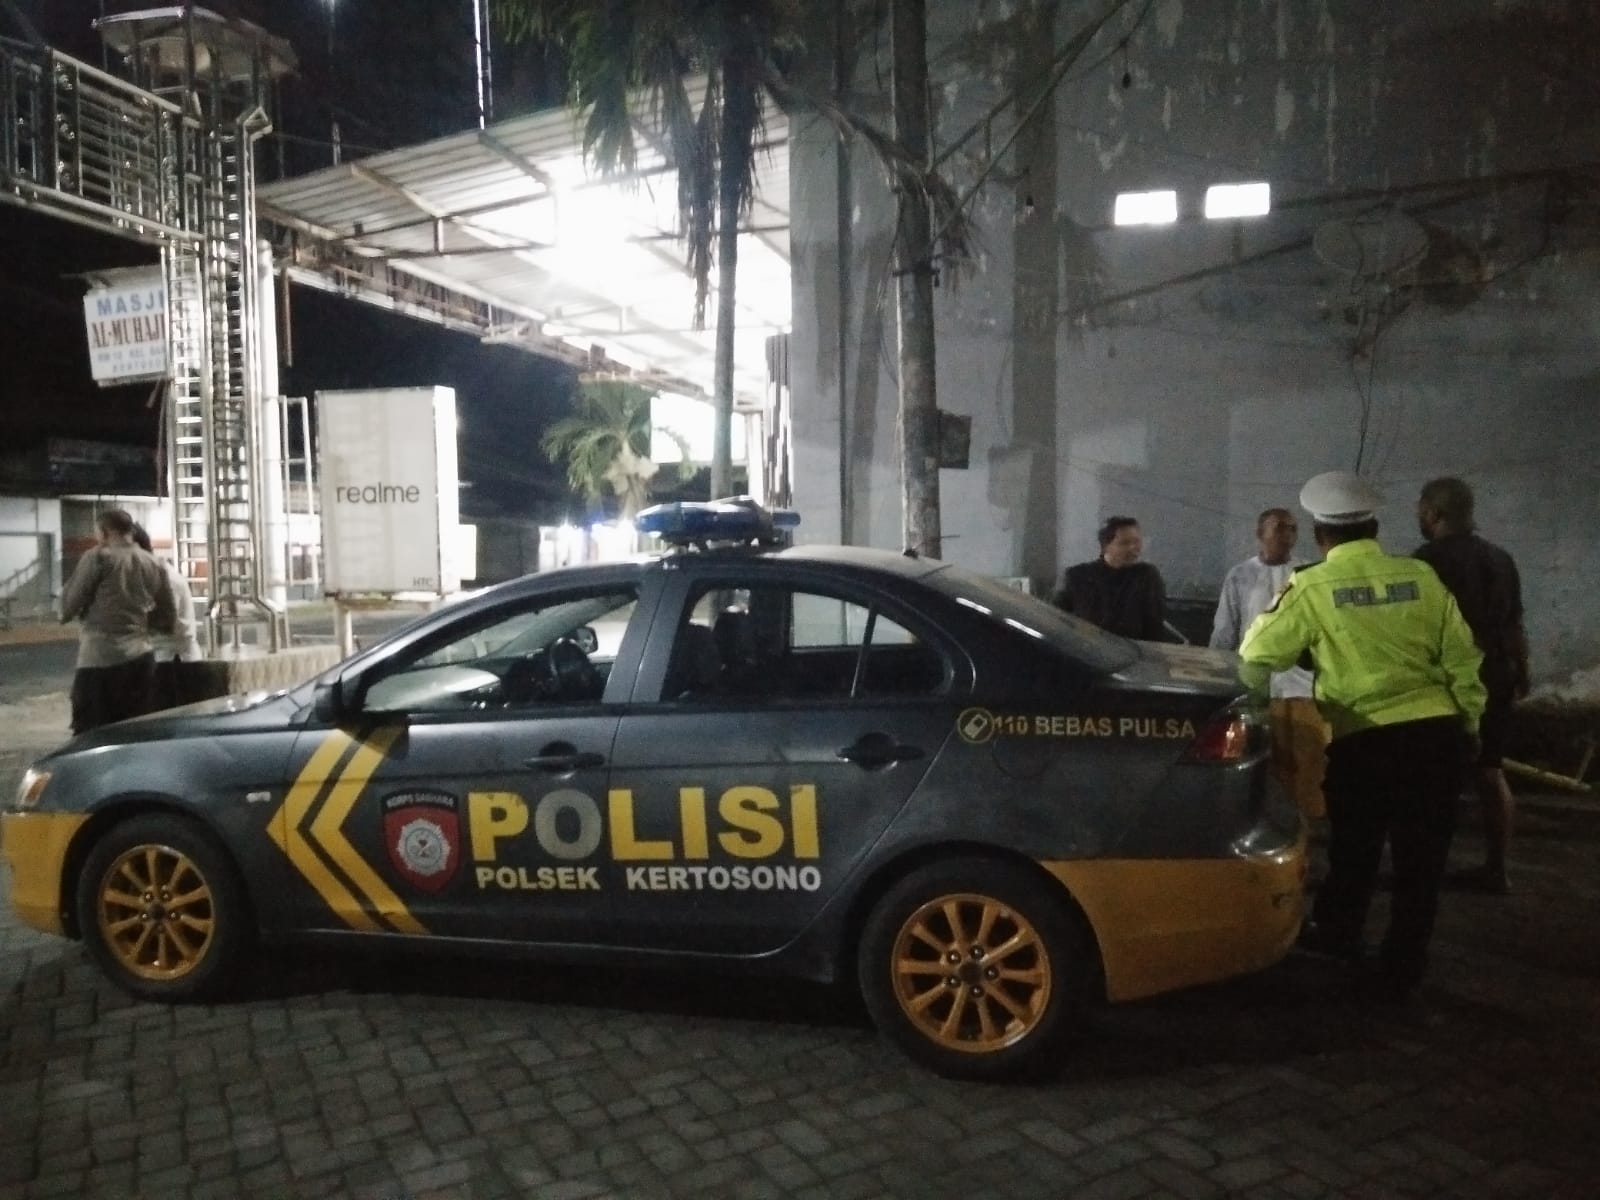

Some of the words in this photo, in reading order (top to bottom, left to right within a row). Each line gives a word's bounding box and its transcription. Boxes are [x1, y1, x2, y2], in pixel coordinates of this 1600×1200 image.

[97, 290, 164, 316] MASJI
[336, 482, 420, 504] realme
[994, 715, 1028, 735] 110
[1034, 715, 1112, 737] BEBAS
[1119, 718, 1196, 739] PULSA
[467, 784, 820, 862] POLISI
[476, 866, 600, 892] POLSEK
[626, 865, 822, 892] KERTOSONO
